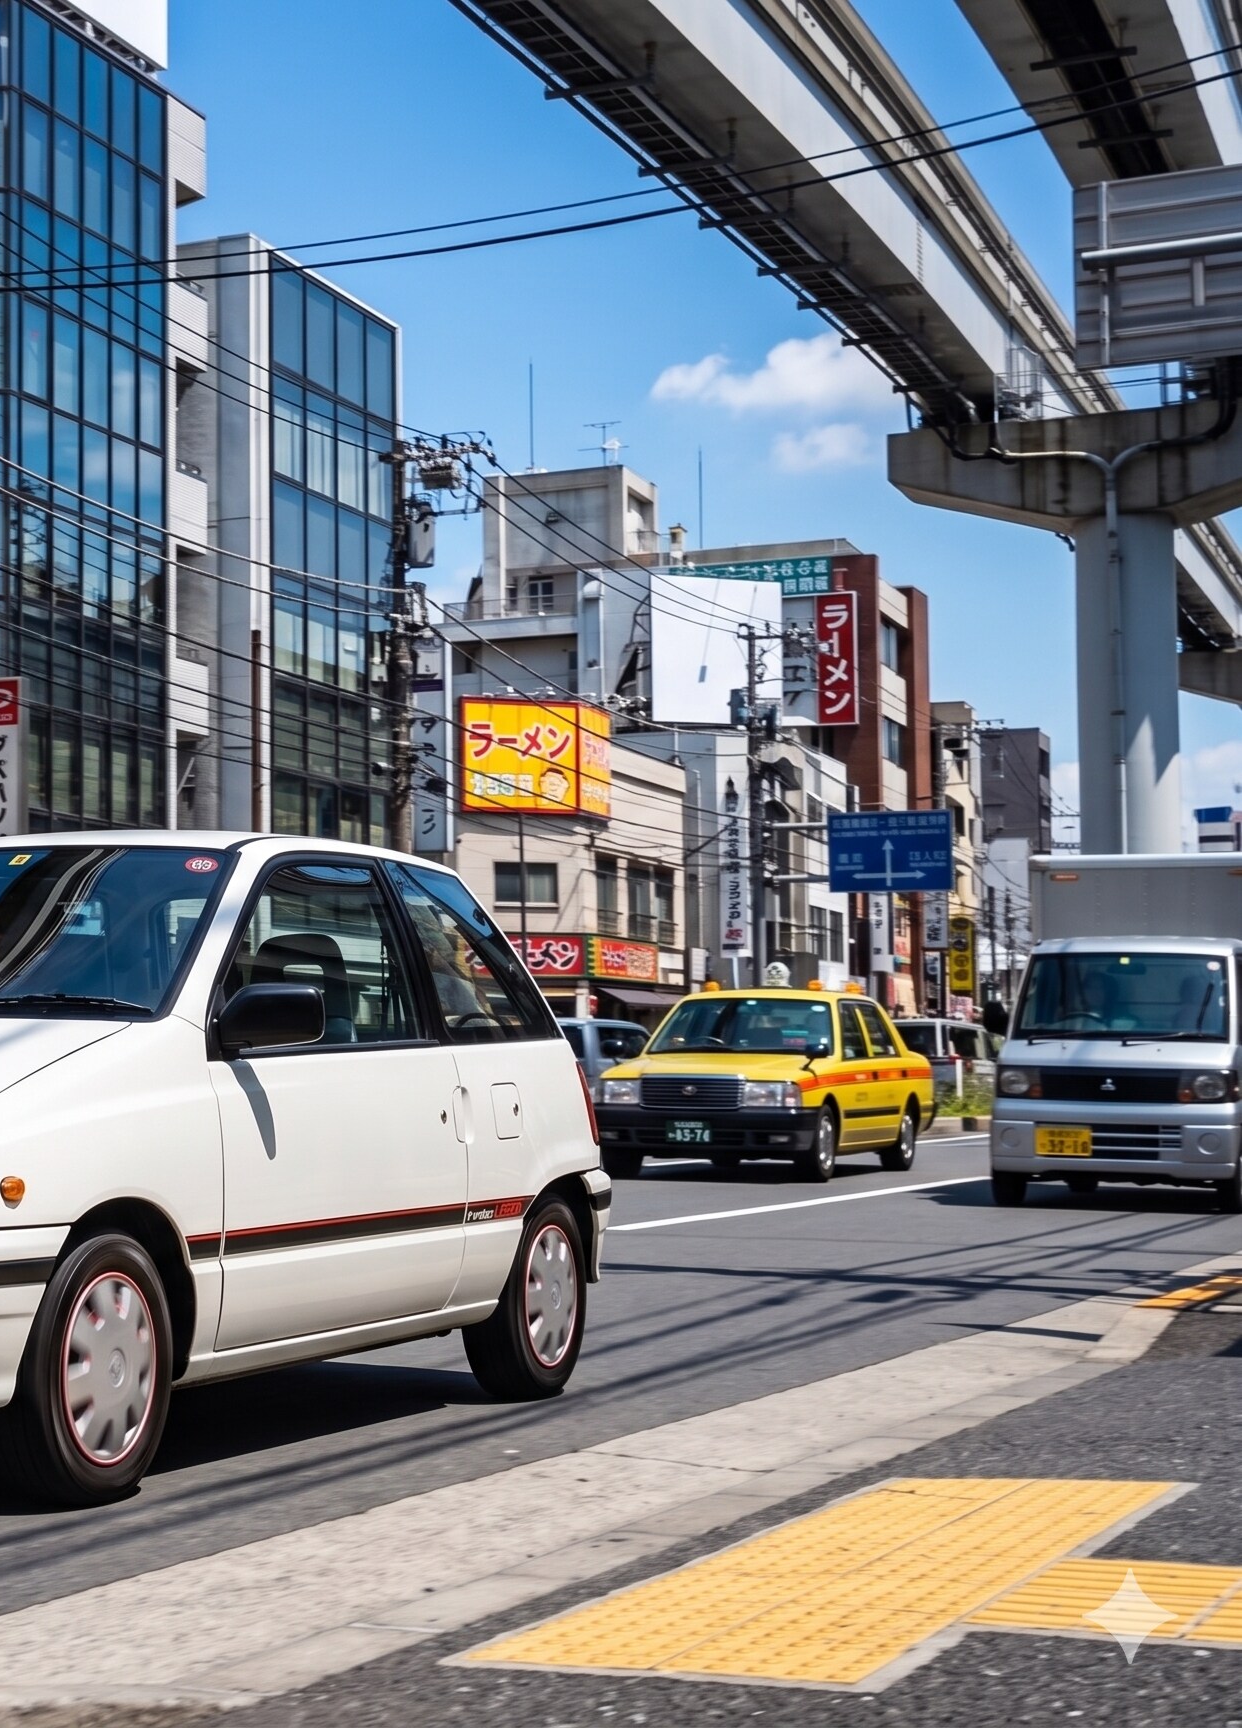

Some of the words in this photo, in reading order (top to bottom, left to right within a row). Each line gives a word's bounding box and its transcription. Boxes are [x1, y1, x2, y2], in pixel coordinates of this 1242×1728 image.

[822, 604, 850, 714] ラーメン
[469, 724, 570, 758] ラーメン
